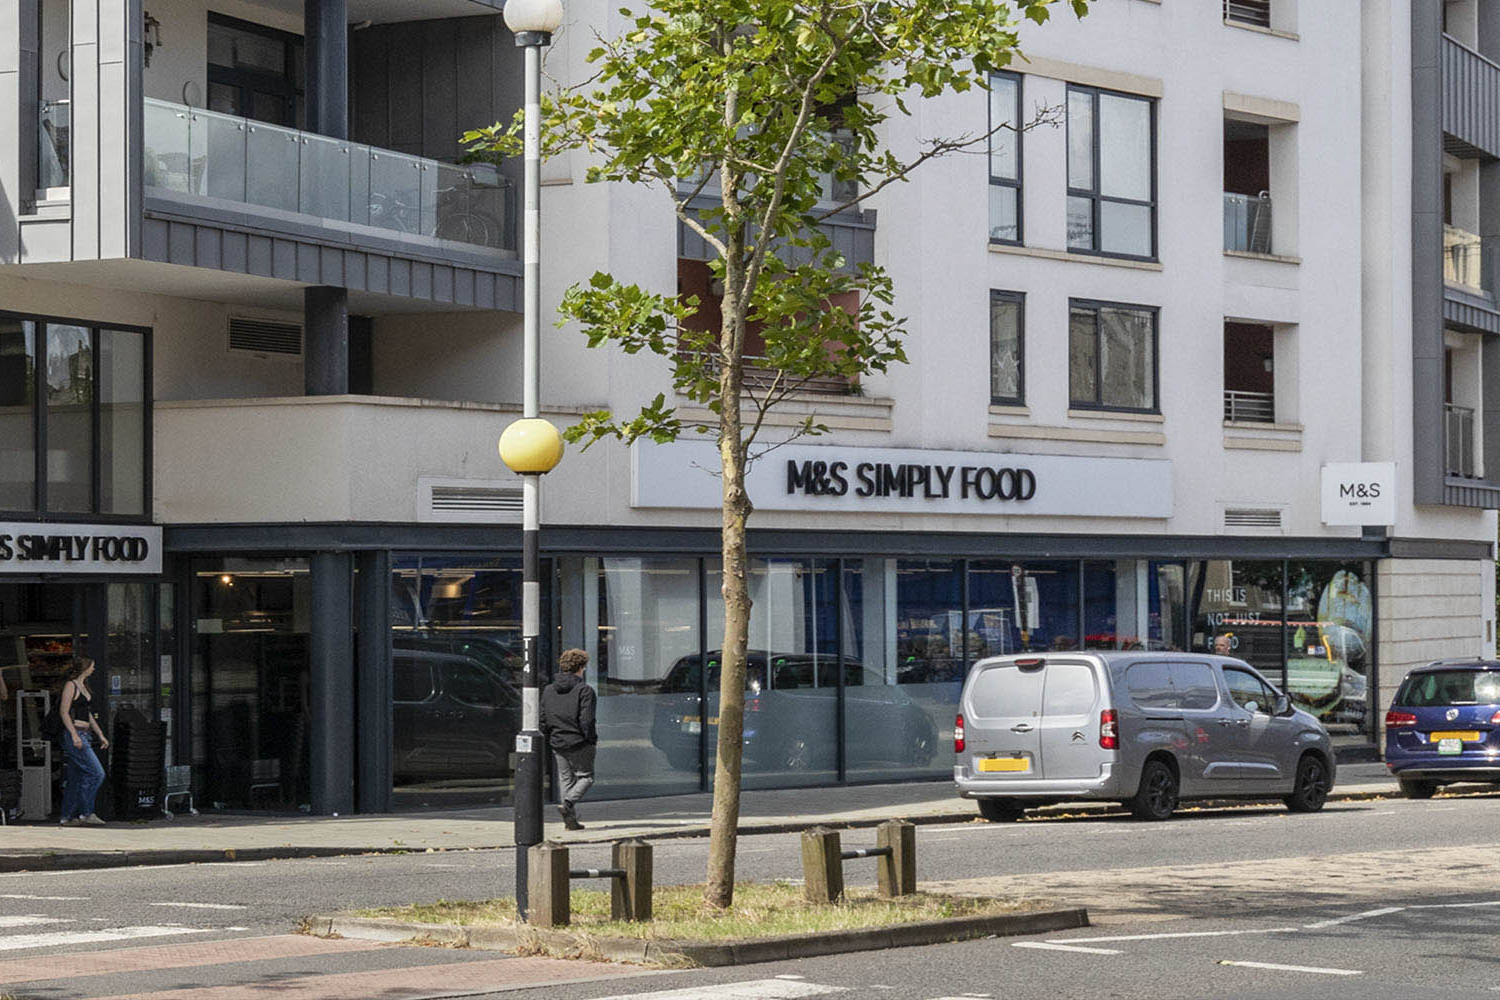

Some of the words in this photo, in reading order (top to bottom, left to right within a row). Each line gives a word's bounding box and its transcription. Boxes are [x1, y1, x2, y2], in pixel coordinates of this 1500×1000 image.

[787, 459, 849, 496] M&S
[855, 462, 956, 499] SIMPLY
[961, 466, 1037, 501] FOOD
[1340, 482, 1381, 498] M&S
[16, 534, 91, 561] SIMPLY
[92, 535, 149, 562] FOOD
[1206, 588, 1231, 602] THIS
[1234, 588, 1247, 602] IS
[1207, 612, 1230, 626] NOT
[1235, 612, 1261, 626] JUST
[1207, 636, 1240, 649] FD
